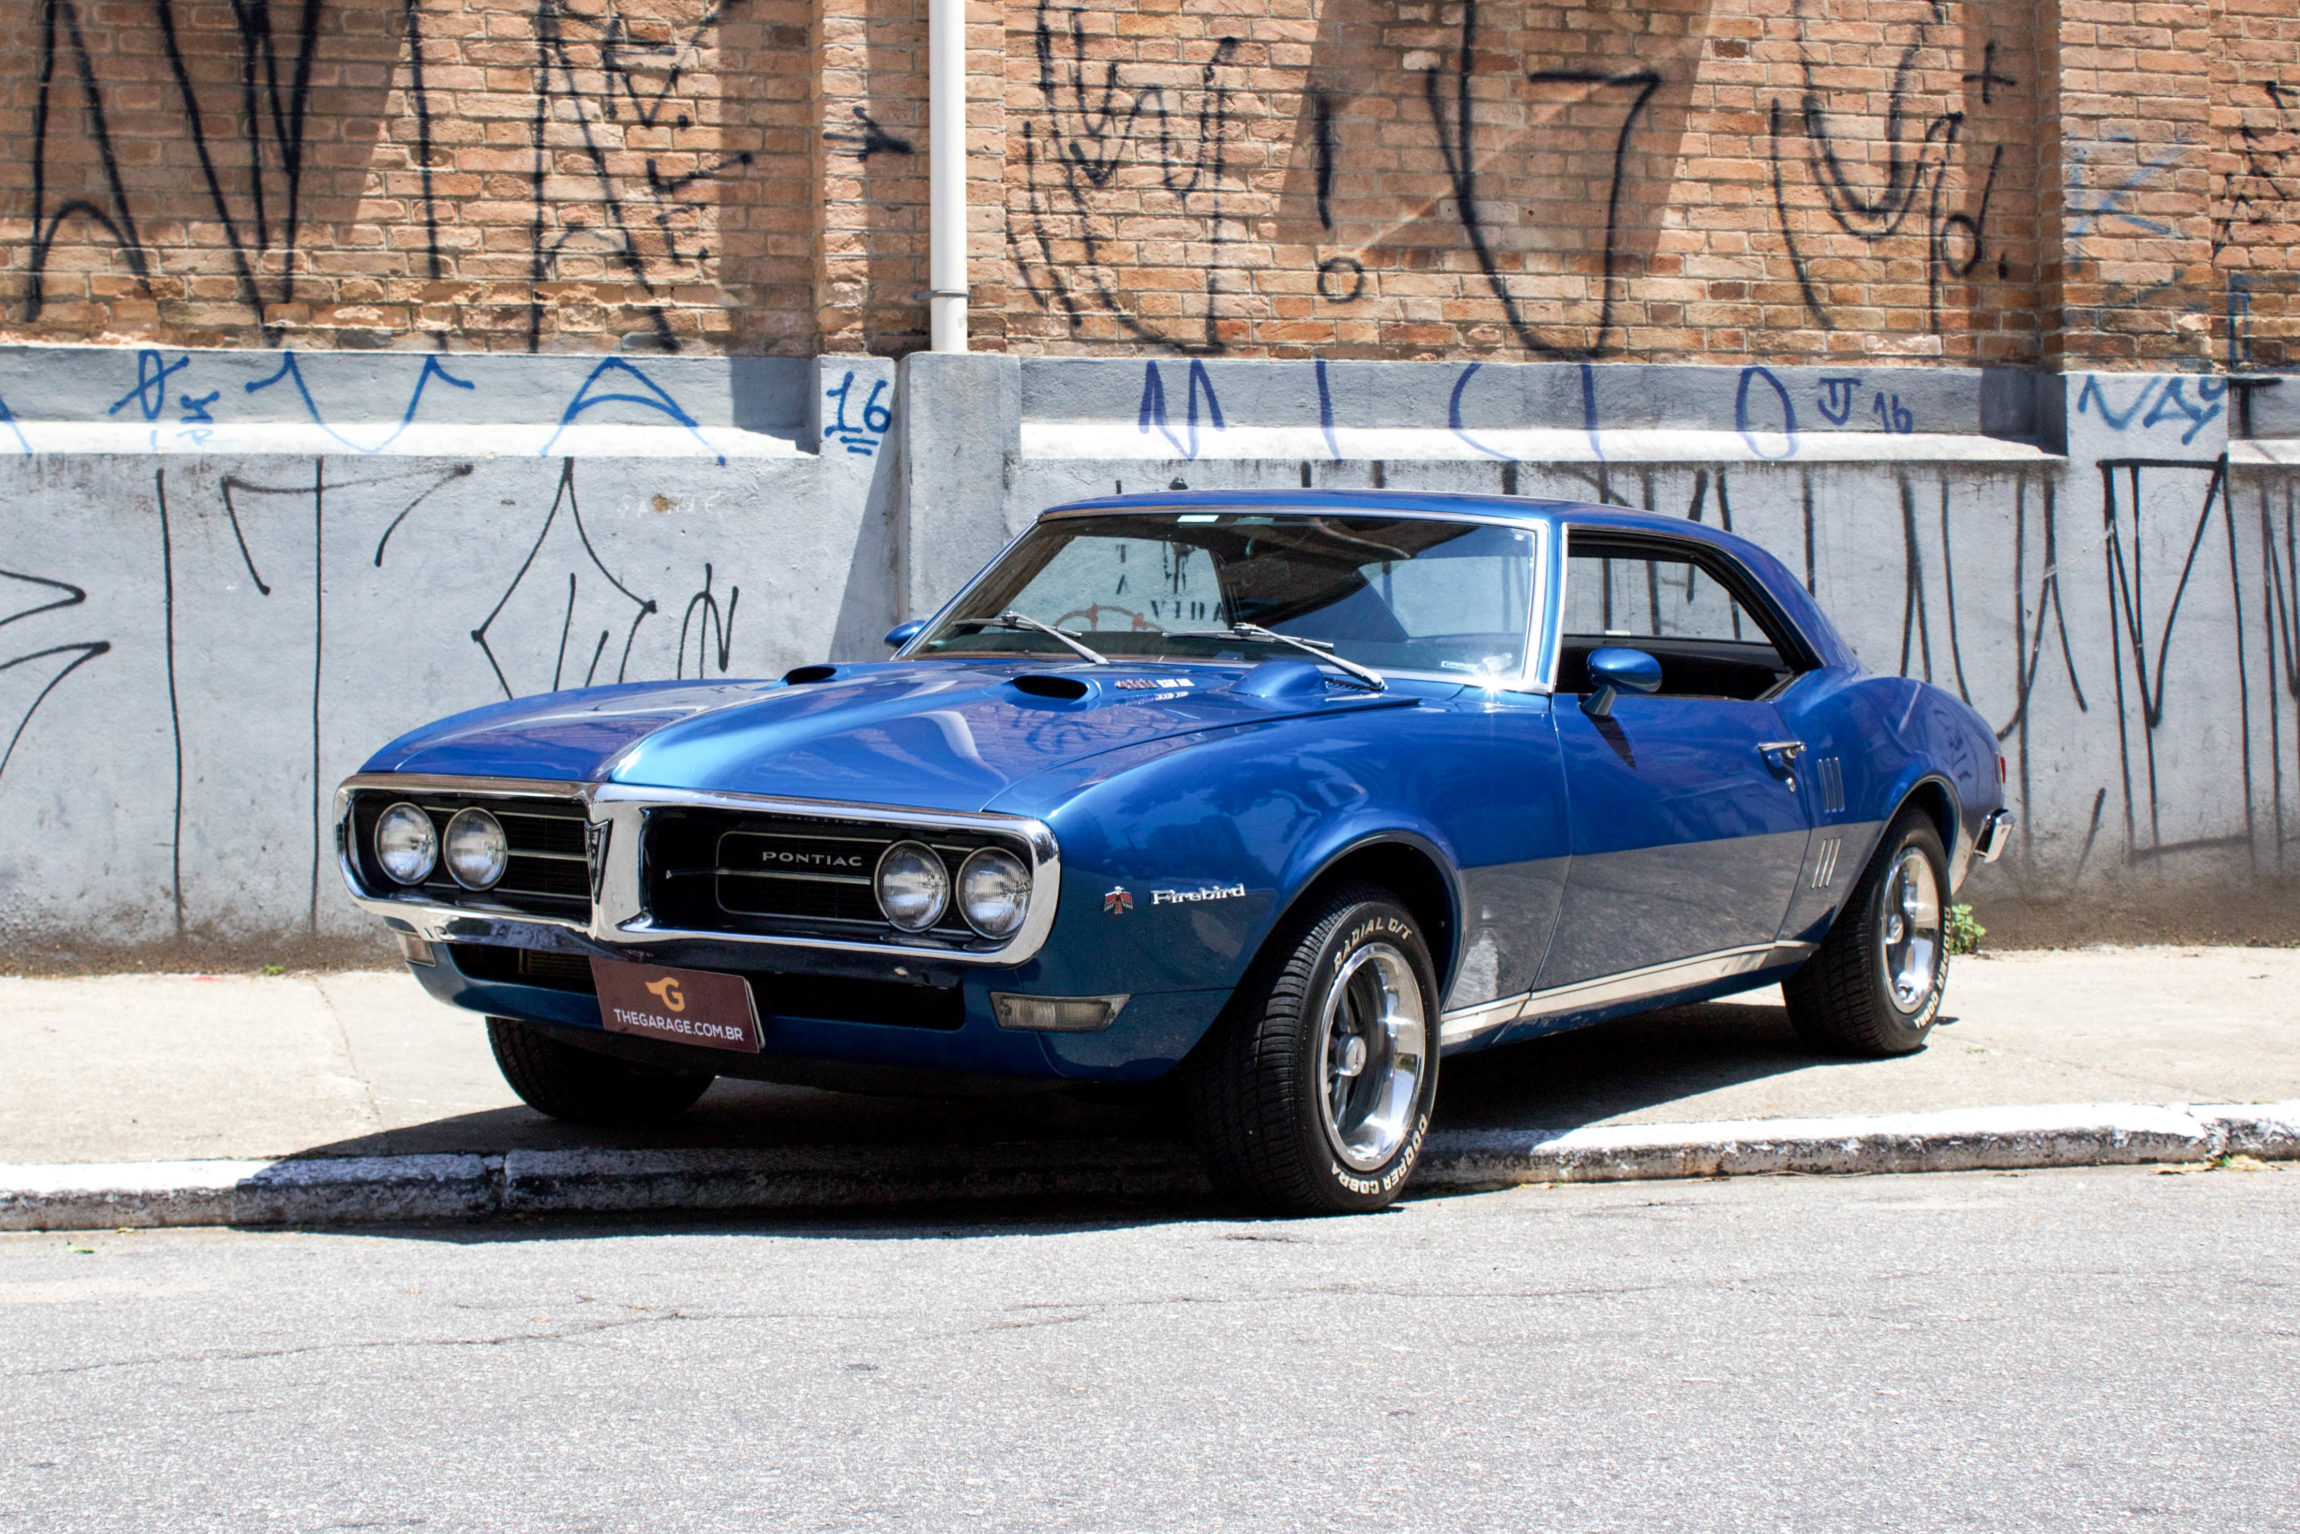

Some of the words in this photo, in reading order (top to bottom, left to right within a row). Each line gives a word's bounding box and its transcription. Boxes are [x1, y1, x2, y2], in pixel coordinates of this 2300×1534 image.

[762, 851, 862, 867] PONTIAC
[1150, 883, 1246, 905] Firebird
[1333, 916, 1384, 974] RADIAL
[613, 1008, 744, 1042] THEGARAGE.COM.BR
[1382, 1113, 1428, 1191] COOPER
[1330, 1159, 1380, 1195] COBRA
